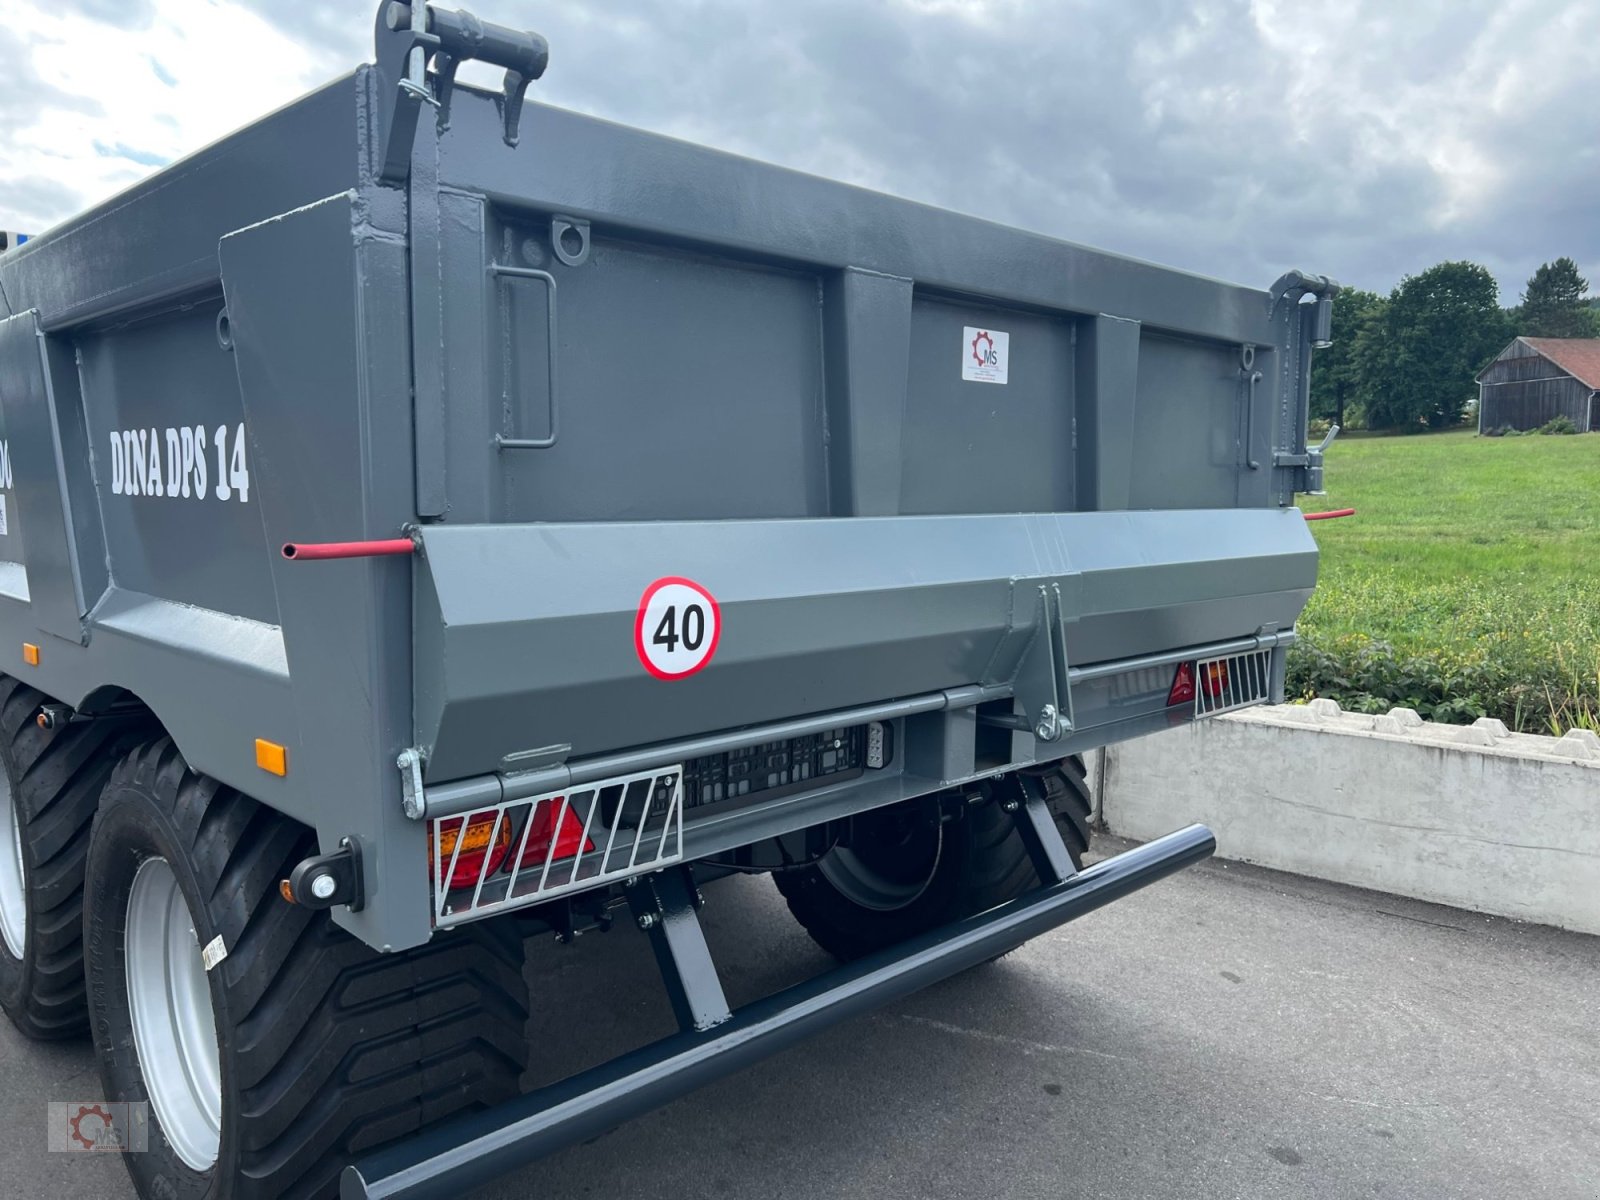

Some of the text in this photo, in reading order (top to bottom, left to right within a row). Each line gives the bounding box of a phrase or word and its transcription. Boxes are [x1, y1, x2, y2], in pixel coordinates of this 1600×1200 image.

[109, 421, 249, 503] DINA DPS 14
[652, 603, 705, 653] 40
